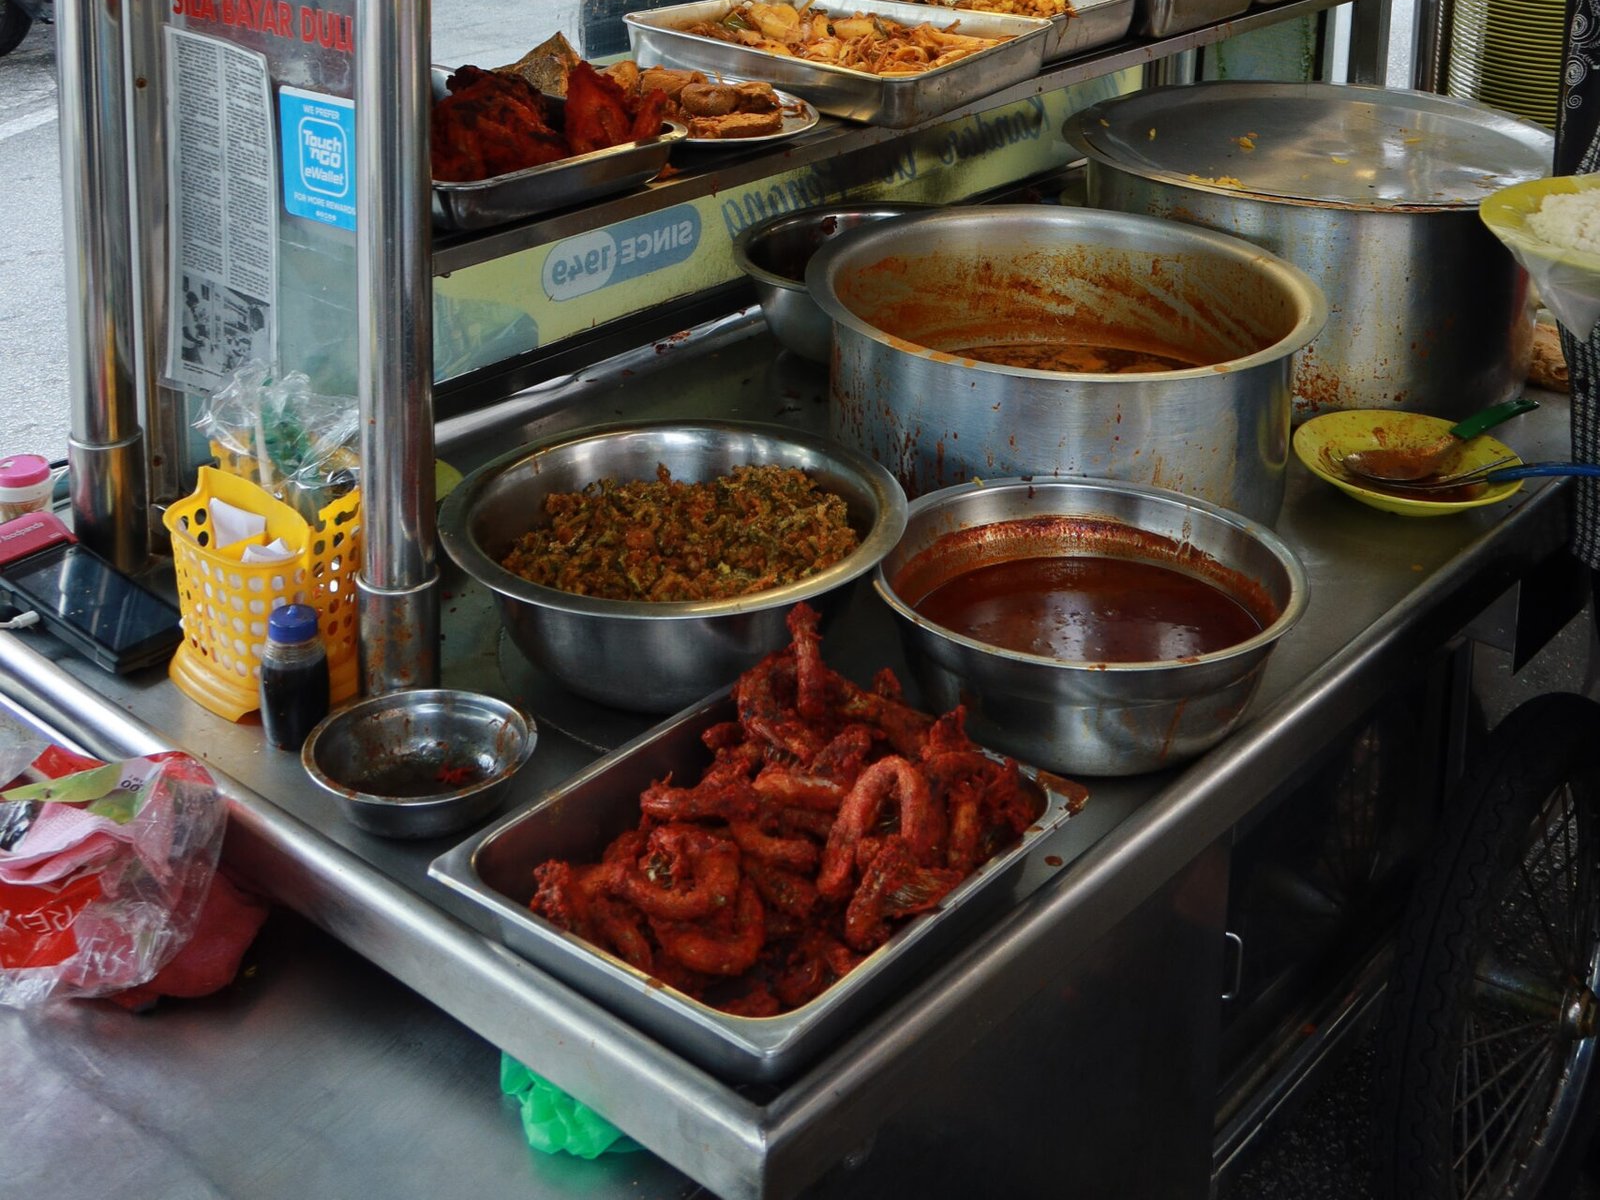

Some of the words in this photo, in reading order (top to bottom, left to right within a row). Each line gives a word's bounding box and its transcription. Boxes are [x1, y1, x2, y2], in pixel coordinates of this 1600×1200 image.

[303, 104, 314, 115] WE
[315, 106, 340, 121] PREFER
[303, 129, 342, 153] Touch
[304, 166, 344, 186] eWallet
[293, 191, 307, 202] FOR
[307, 194, 325, 207] MORE
